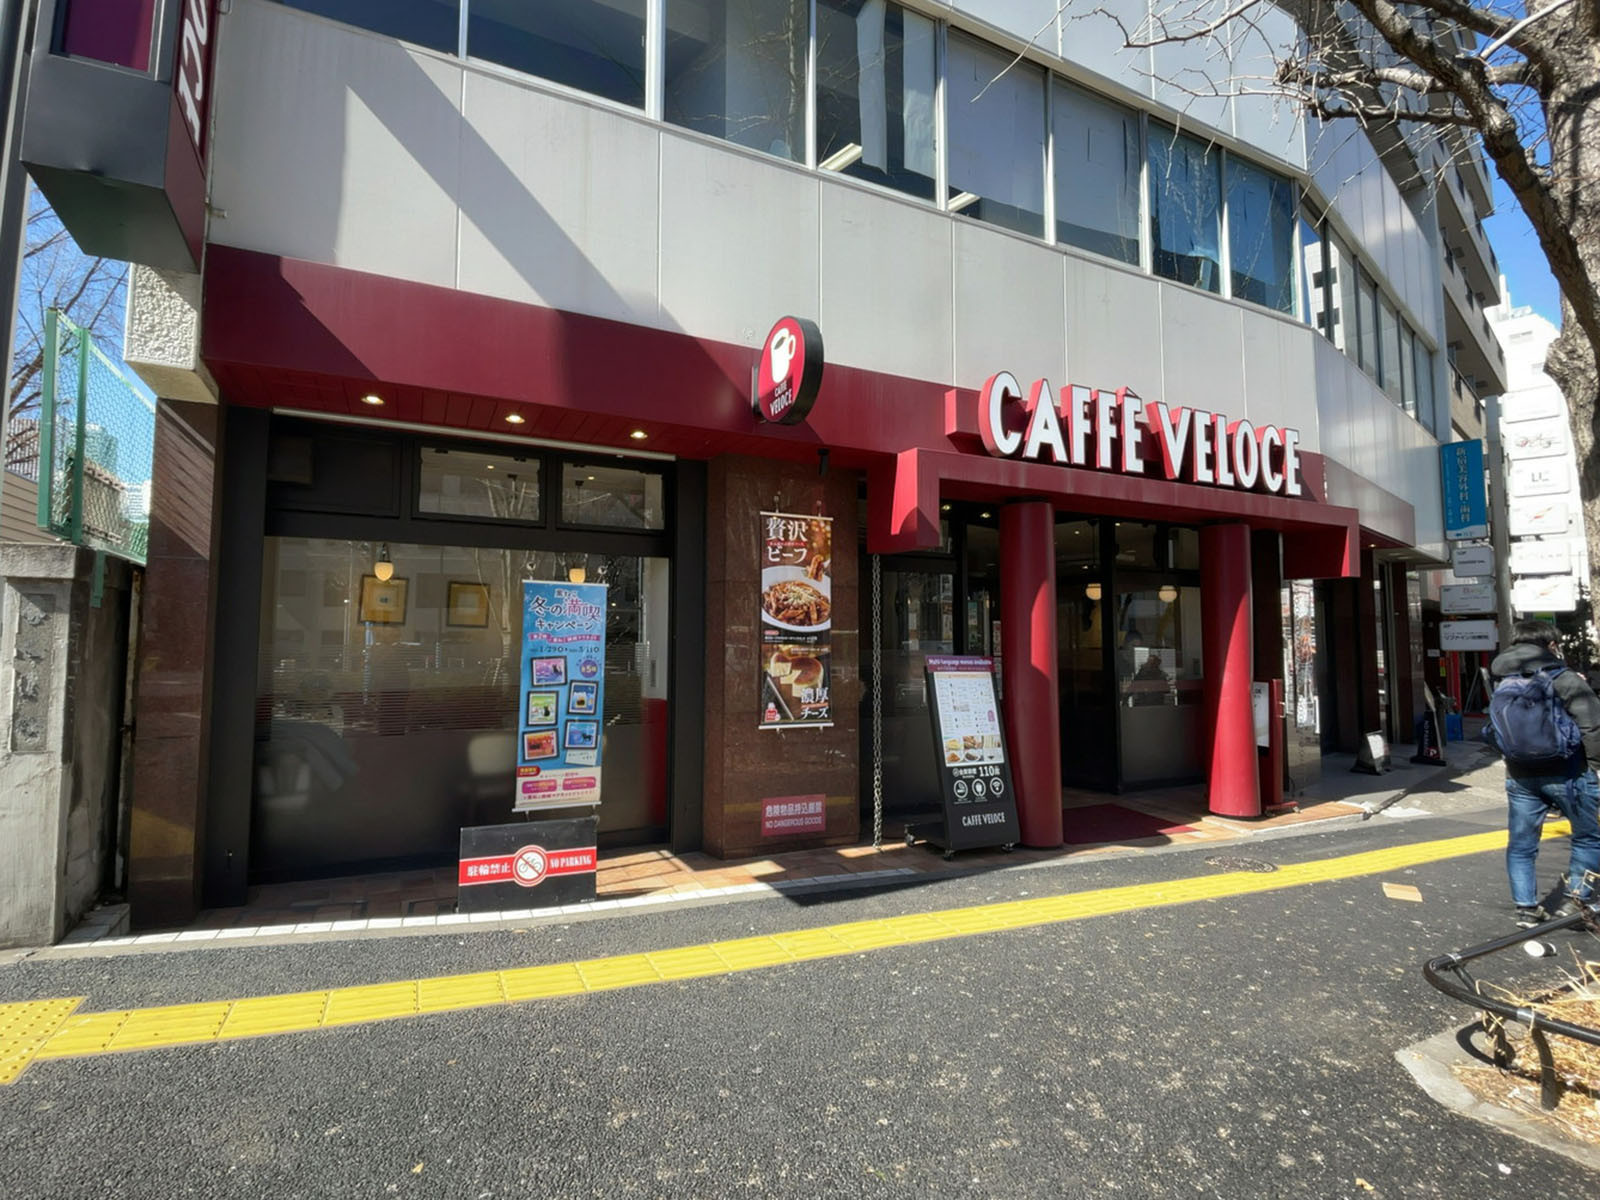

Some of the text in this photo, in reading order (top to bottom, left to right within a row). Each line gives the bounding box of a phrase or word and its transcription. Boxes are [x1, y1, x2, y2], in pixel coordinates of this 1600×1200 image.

[769, 388, 793, 416] VELOCE
[1147, 401, 1302, 496] VELOCE
[766, 517, 808, 541] 贅沢
[767, 545, 808, 564] ビーフ
[531, 596, 601, 621] 冬の満喫
[536, 620, 593, 631] キャンペーン
[800, 687, 829, 704] 濃厚
[800, 706, 829, 720] チーズ
[982, 812, 1006, 825] VELOCE
[467, 862, 511, 877] 駐輪禁止
[550, 855, 592, 869] NO PARKING
